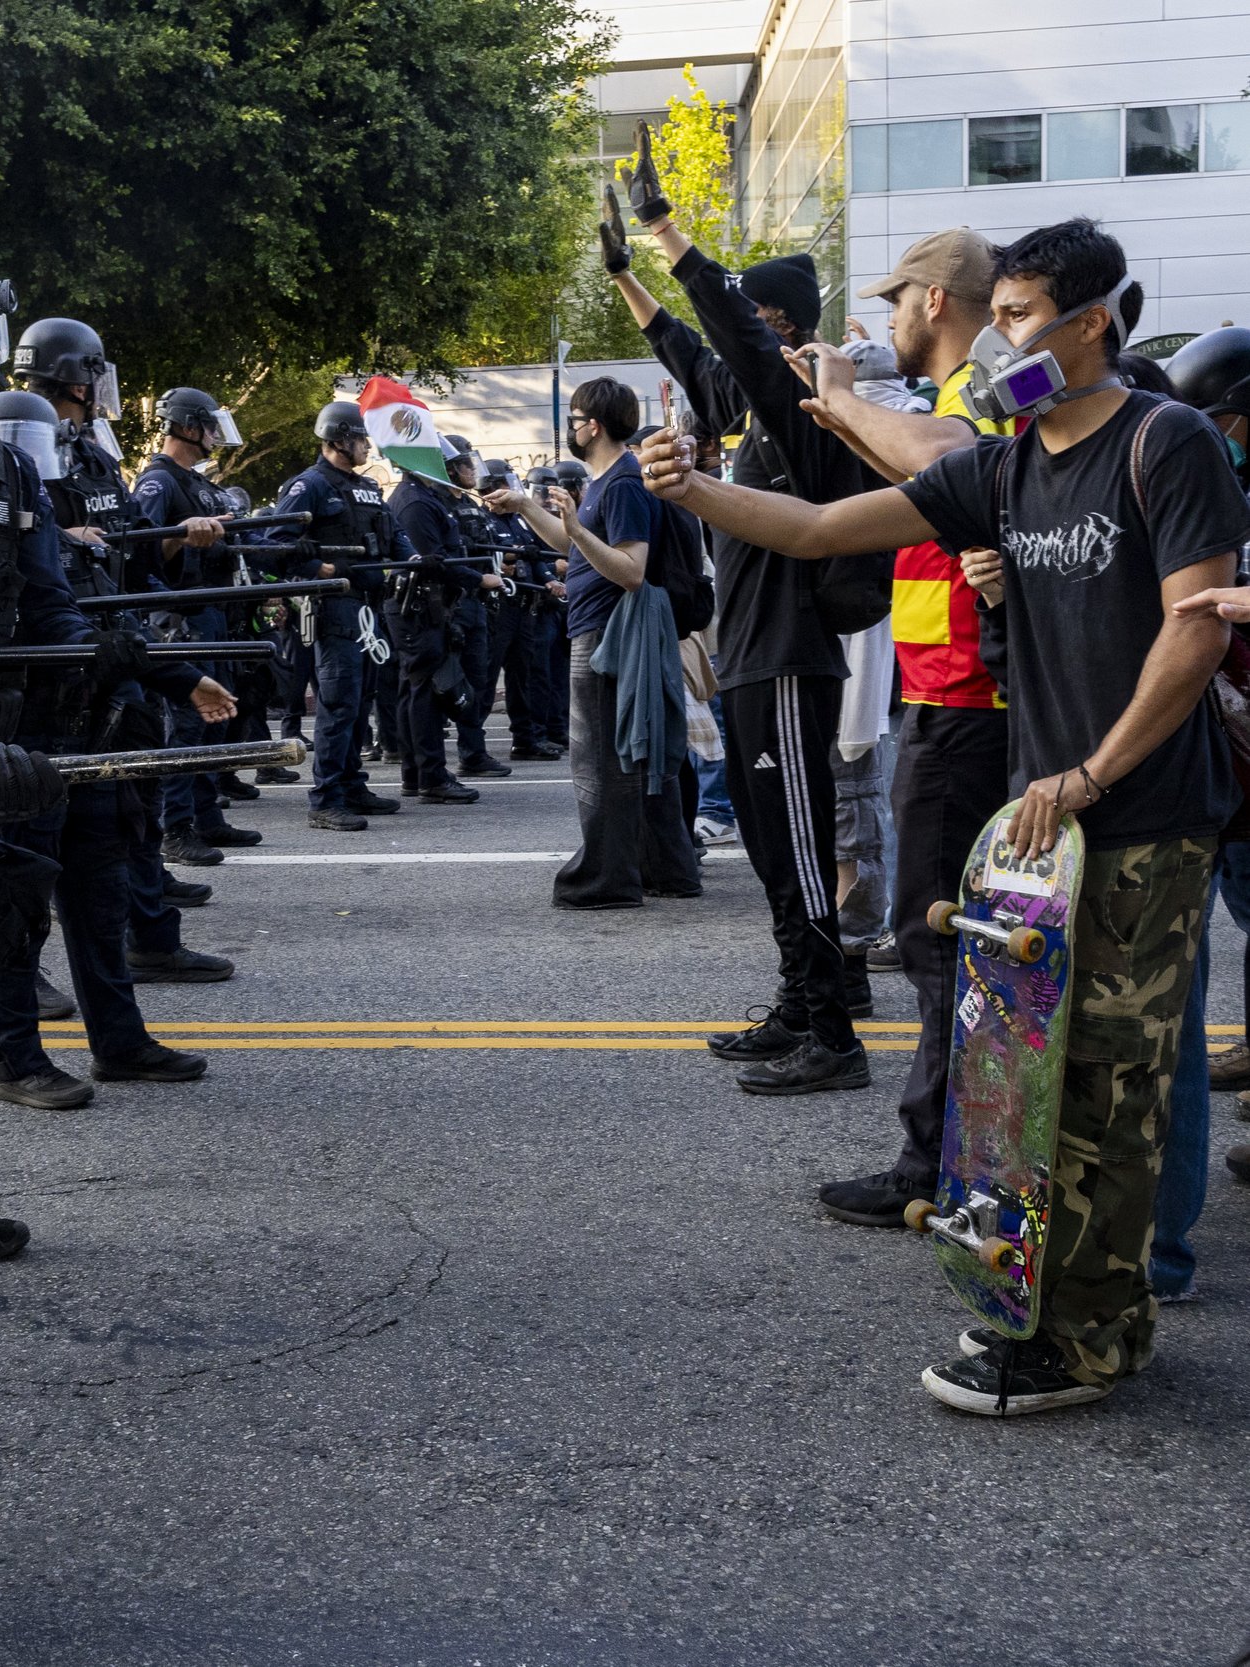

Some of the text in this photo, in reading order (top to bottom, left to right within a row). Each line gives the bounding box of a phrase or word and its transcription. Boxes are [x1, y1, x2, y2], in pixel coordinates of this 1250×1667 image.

[1164, 336, 1197, 349] CENT
[85, 493, 119, 513] POLICE
[352, 489, 382, 505] POLICE
